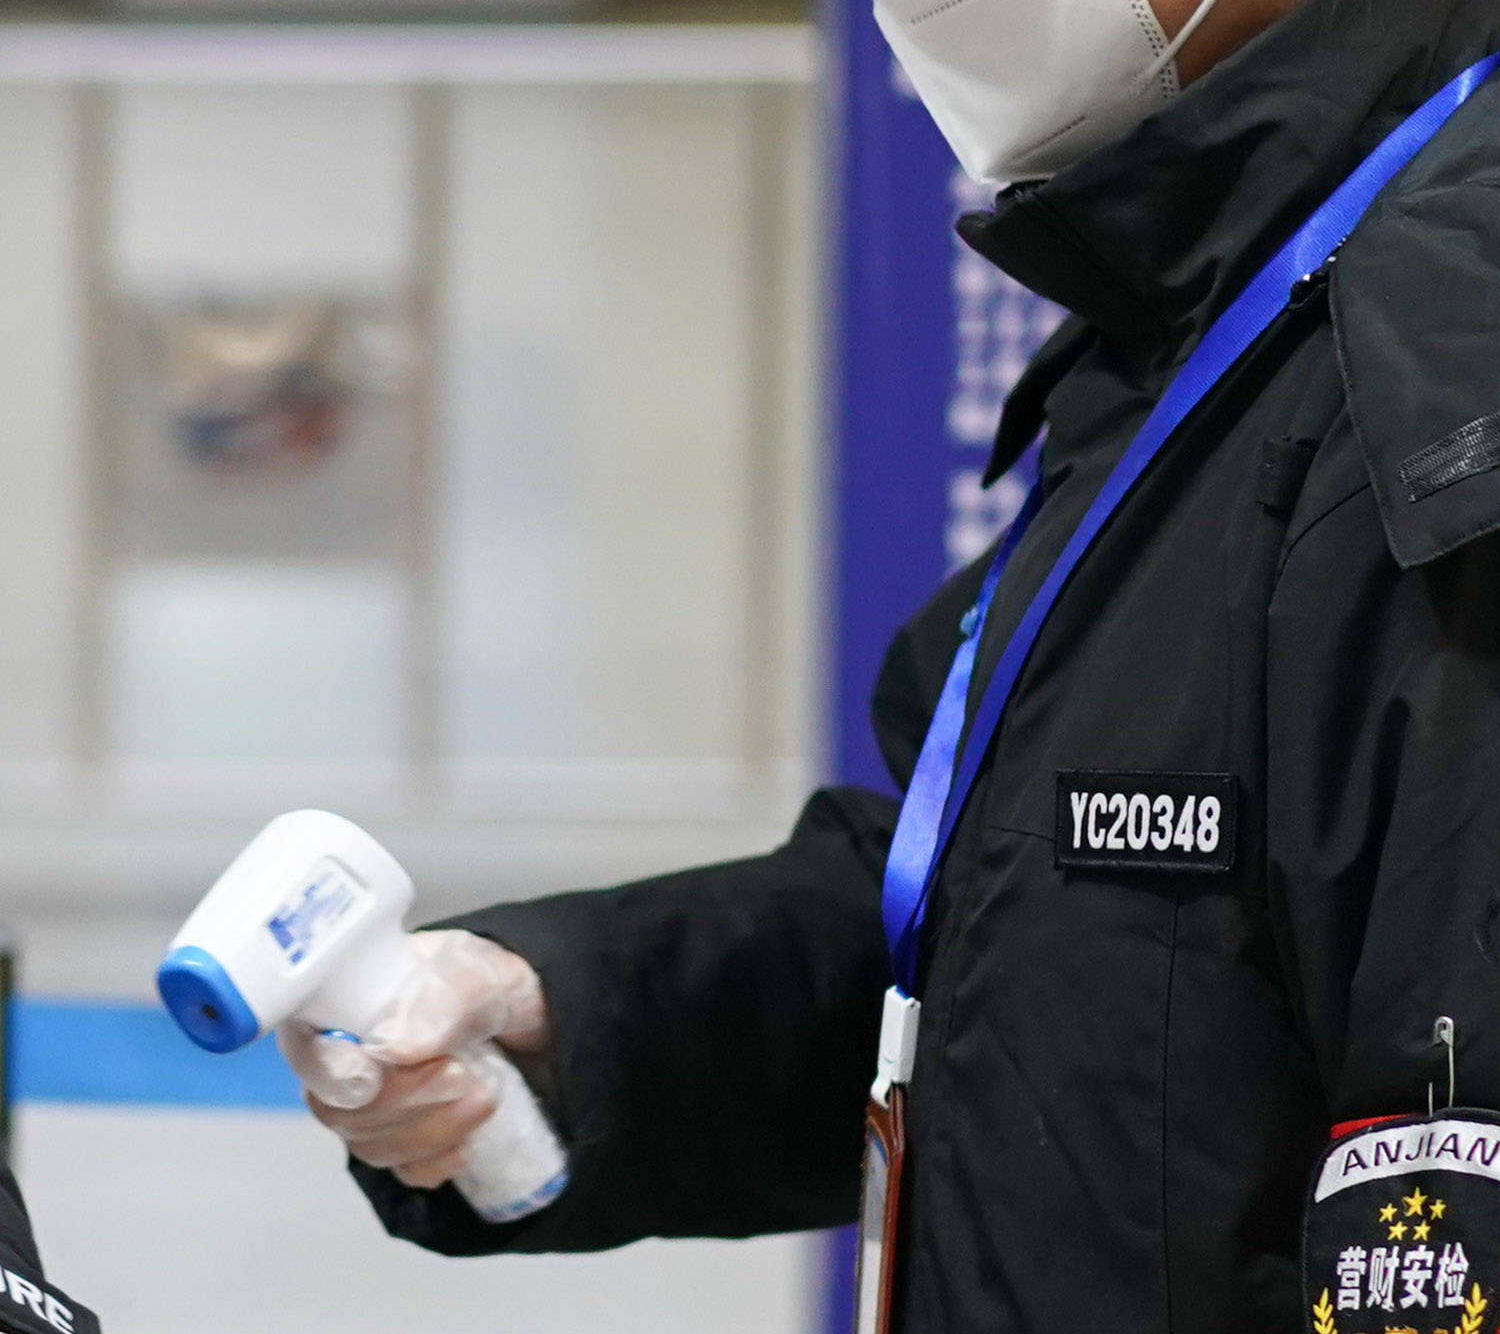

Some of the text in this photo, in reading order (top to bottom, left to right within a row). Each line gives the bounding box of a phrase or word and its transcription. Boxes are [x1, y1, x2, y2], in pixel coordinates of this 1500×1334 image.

[1069, 791, 1222, 853] YC20348
[1336, 1241, 1470, 1313] 营财安检
